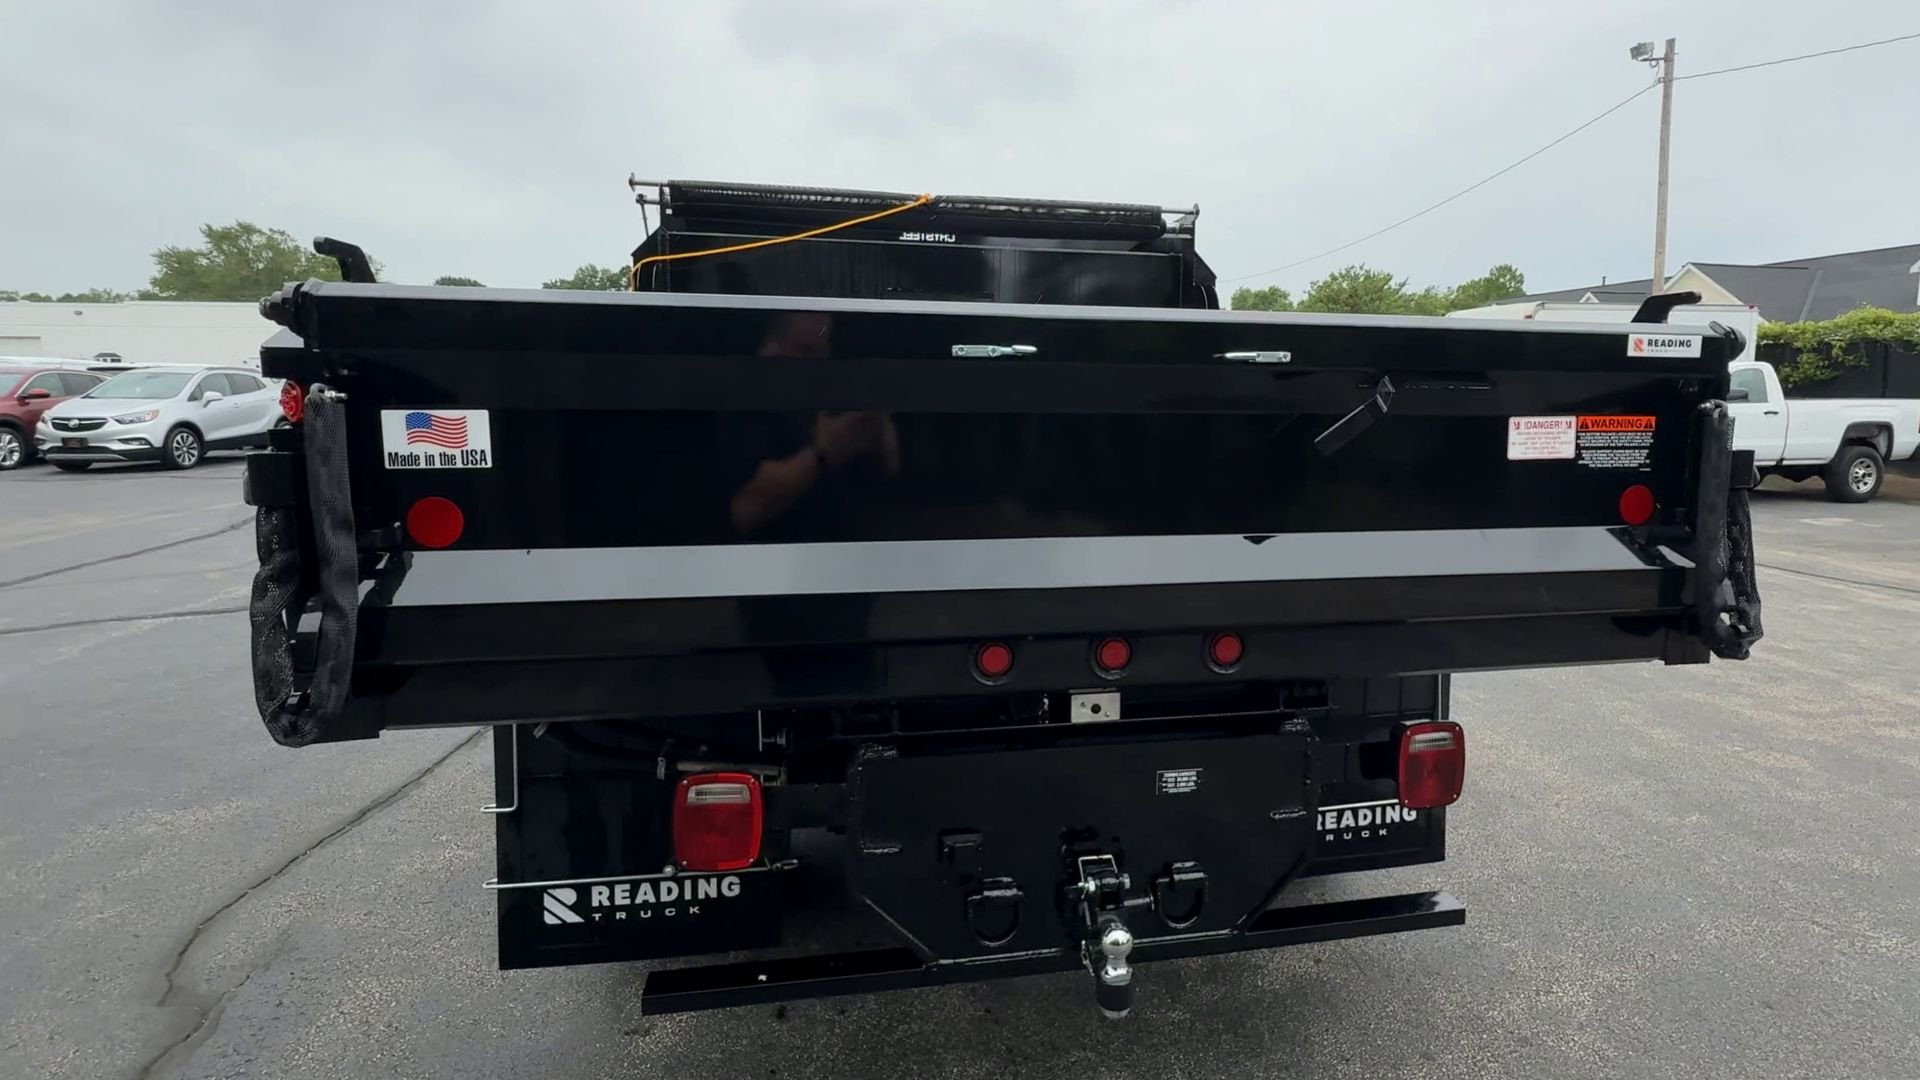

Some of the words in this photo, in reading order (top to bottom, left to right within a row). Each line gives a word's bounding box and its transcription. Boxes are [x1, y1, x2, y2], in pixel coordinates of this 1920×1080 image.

[1647, 338, 1692, 348] READING
[1590, 418, 1643, 429] WARNING
[387, 452, 421, 467] Made
[424, 451, 435, 467] in
[439, 451, 457, 466] the
[460, 449, 488, 466] USA
[1325, 828, 1388, 841] RUCK
[591, 875, 741, 907] READING
[592, 905, 701, 922] TRUCK
